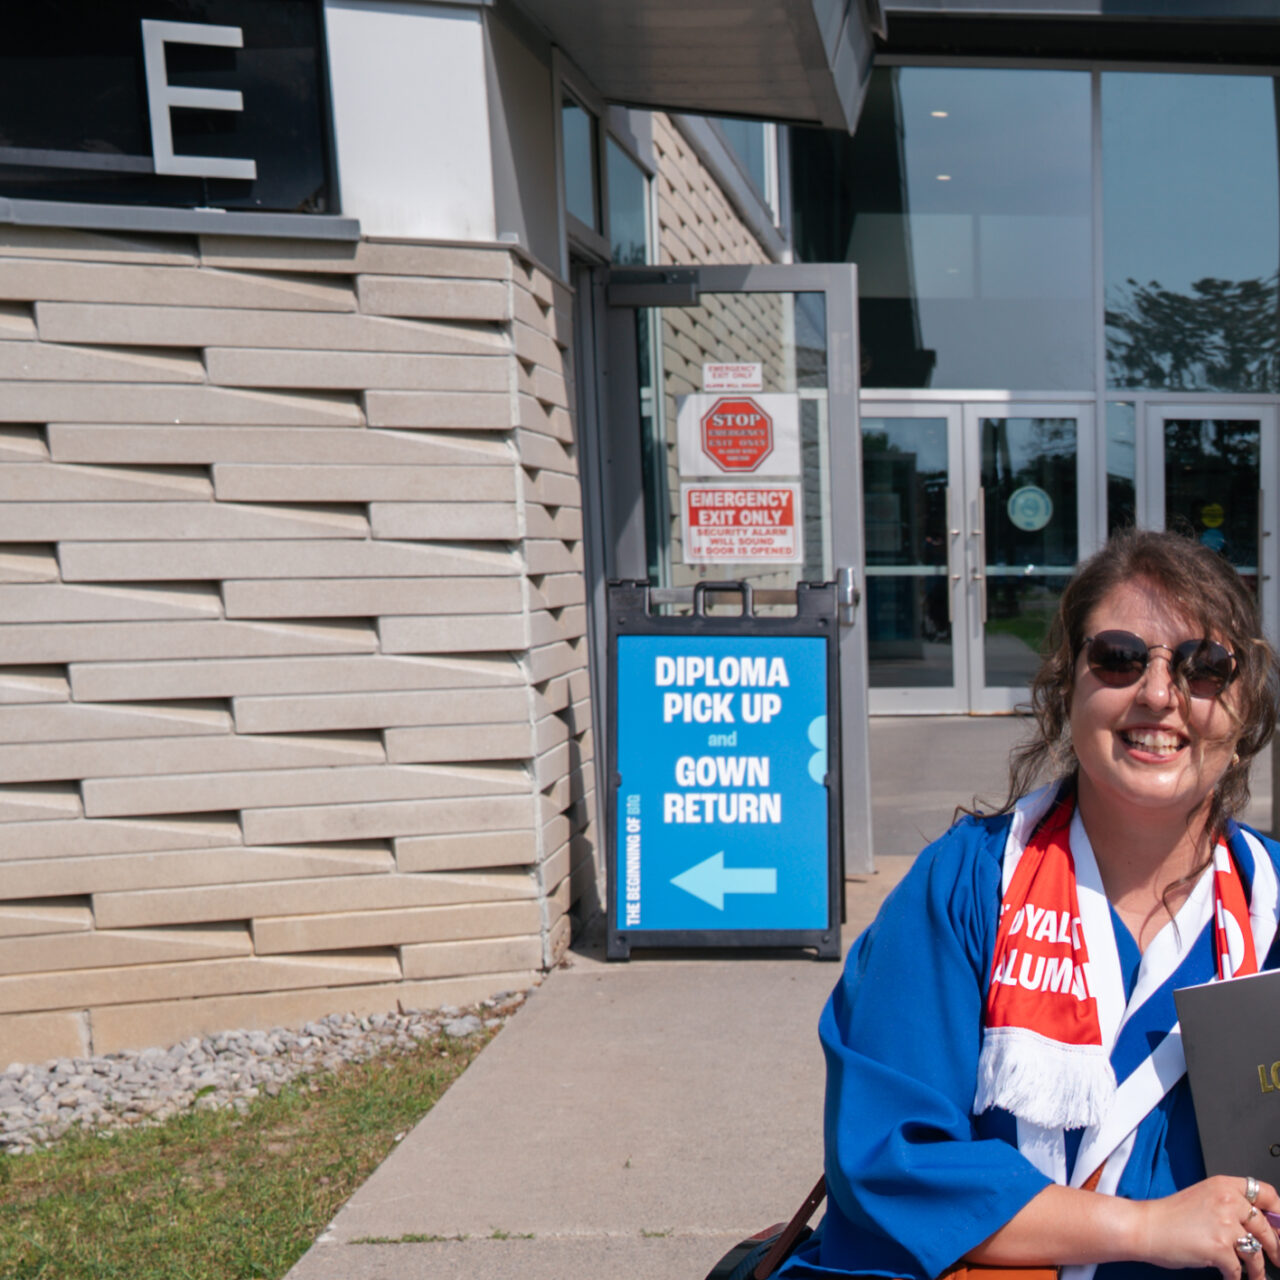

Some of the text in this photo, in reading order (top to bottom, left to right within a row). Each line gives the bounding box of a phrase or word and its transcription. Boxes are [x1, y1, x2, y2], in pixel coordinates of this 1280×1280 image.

[141, 18, 257, 180] E
[712, 413, 761, 426] STOP
[690, 491, 790, 508] EMERGENCY
[698, 509, 783, 525] EXIT ONLY
[697, 528, 788, 537] SECURITY ALARM
[710, 537, 774, 546] WILL SOUND
[706, 546, 735, 555] DOOR
[738, 546, 748, 555] IS
[750, 546, 792, 555] OPENED
[655, 656, 790, 687] DIPLOMA
[663, 692, 782, 723] PICK UP
[708, 731, 737, 747] and
[675, 756, 770, 787] GOWN
[663, 793, 781, 823] RETURN
[626, 816, 641, 833] OF
[626, 834, 641, 901] BEGINNING
[626, 902, 641, 926] THE
